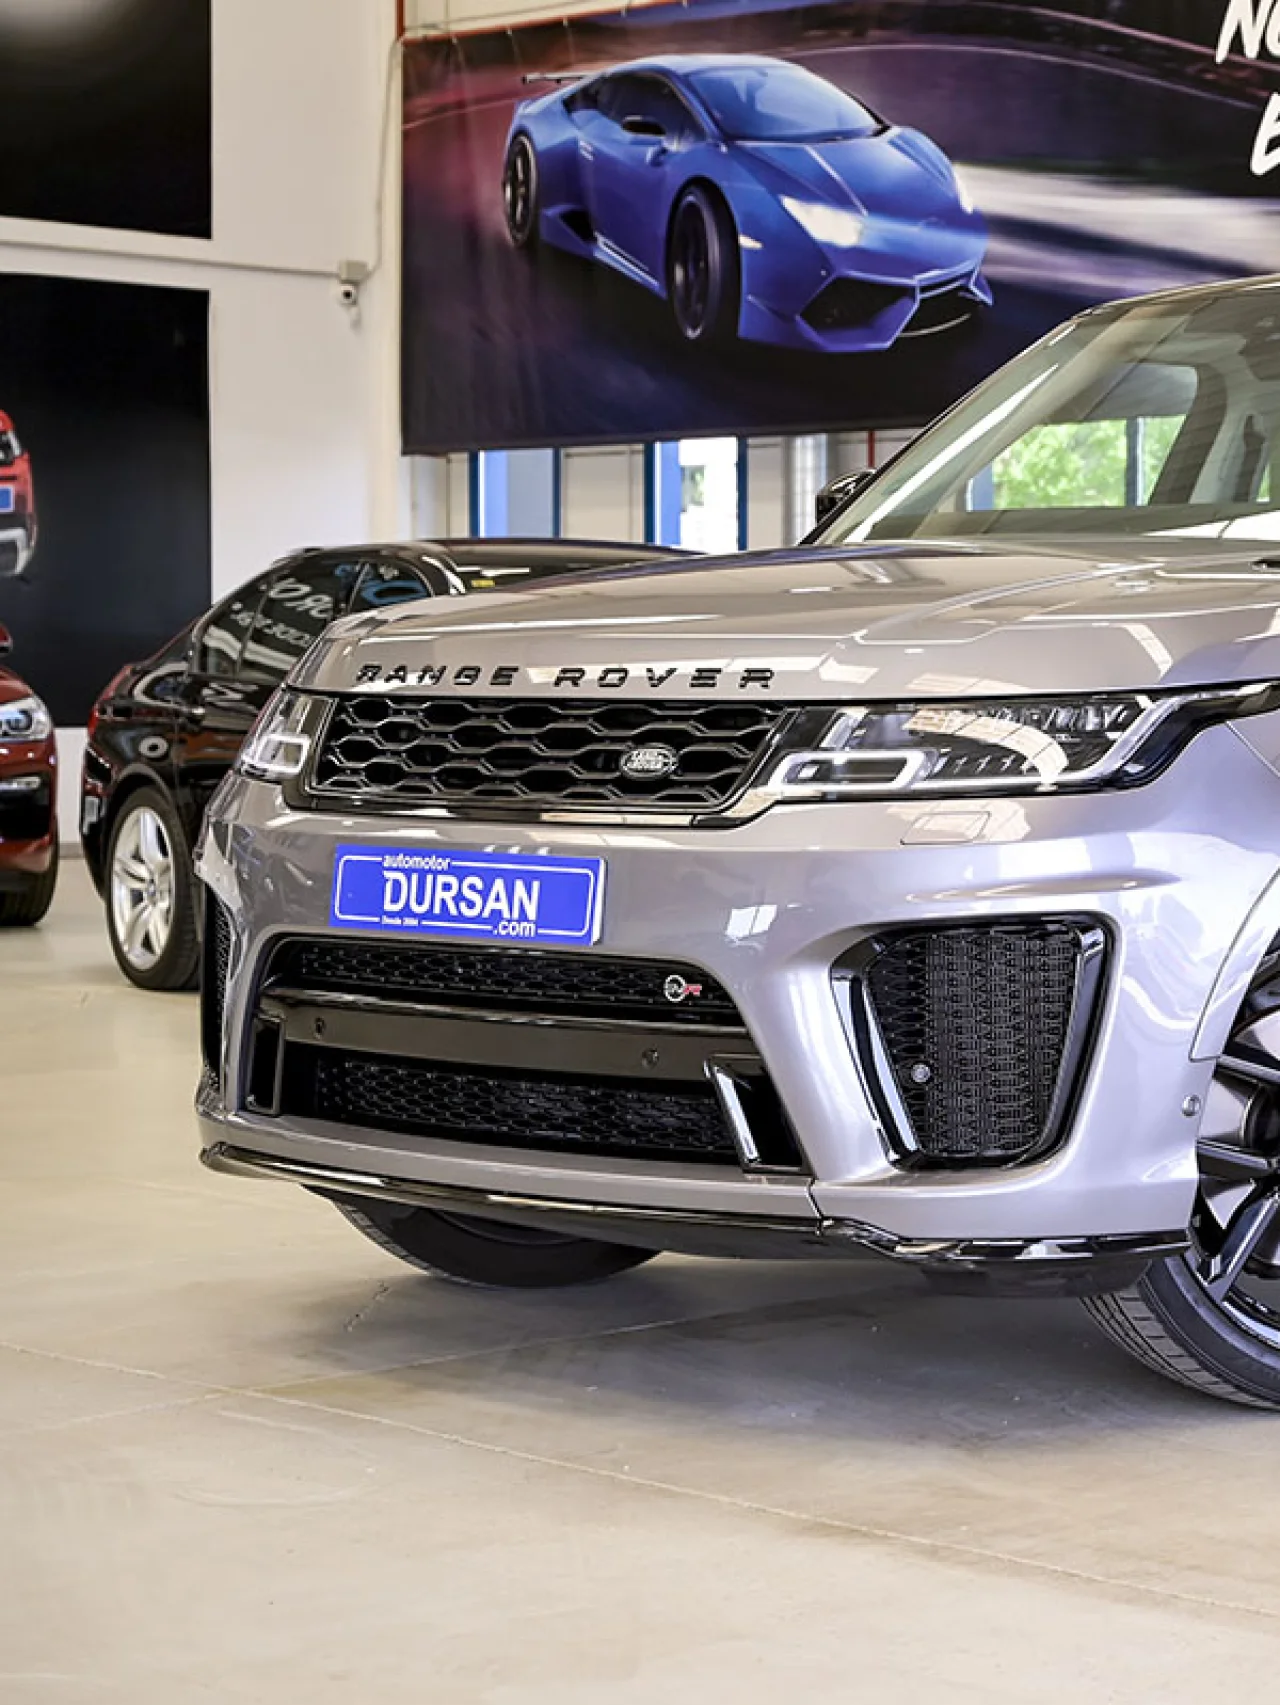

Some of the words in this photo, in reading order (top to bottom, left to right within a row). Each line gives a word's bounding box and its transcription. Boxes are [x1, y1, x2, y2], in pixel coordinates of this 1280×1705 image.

[356, 664, 520, 686] RANGE
[552, 667, 775, 688] ROVER
[382, 853, 450, 871] automotor
[383, 870, 541, 921] DURSAN
[492, 918, 536, 938] .com
